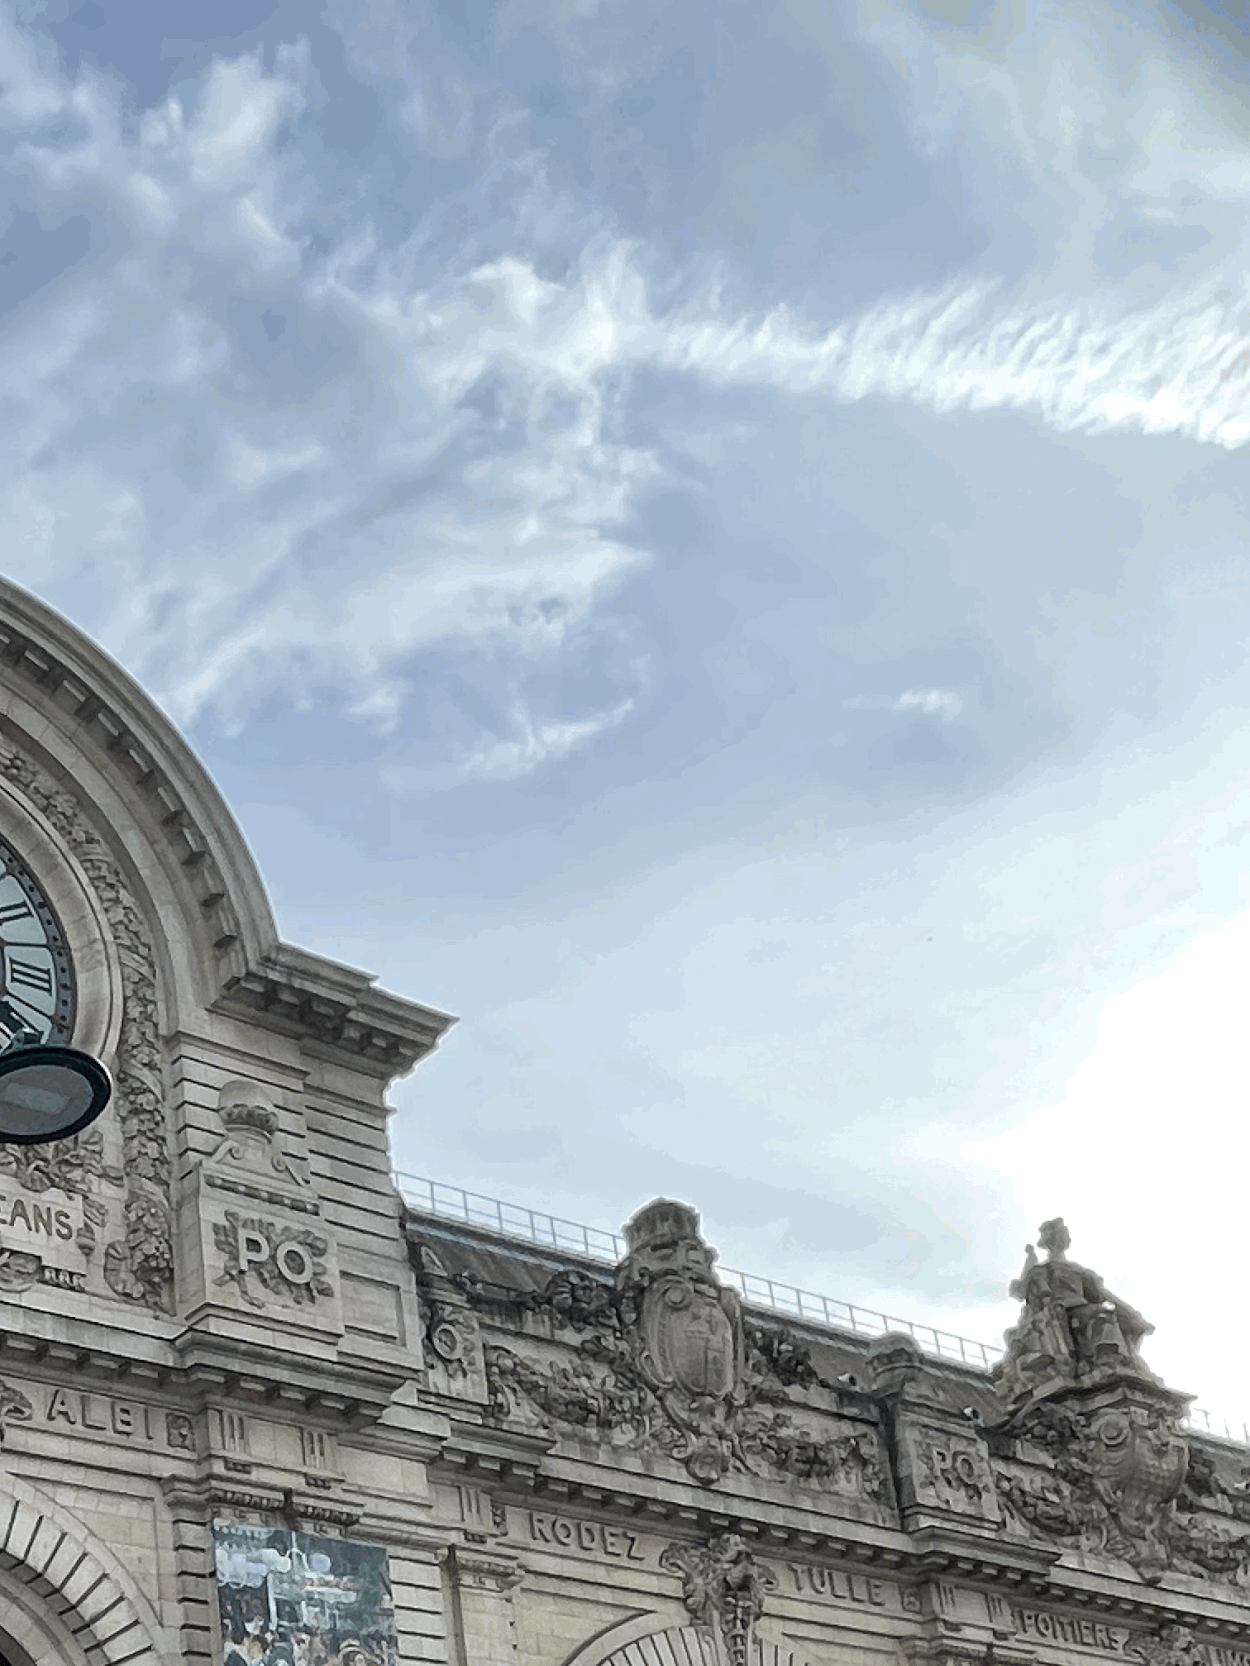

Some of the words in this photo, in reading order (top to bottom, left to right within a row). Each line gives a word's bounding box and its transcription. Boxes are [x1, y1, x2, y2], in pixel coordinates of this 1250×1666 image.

[9, 957, 52, 997] III
[238, 1228, 314, 1285] PO
[47, 1389, 154, 1440] ALBI
[932, 1446, 976, 1485] PO
[529, 1511, 646, 1561] RODEZ
[786, 1562, 886, 1607] TULLE
[1019, 1609, 1120, 1651] POITIERS
